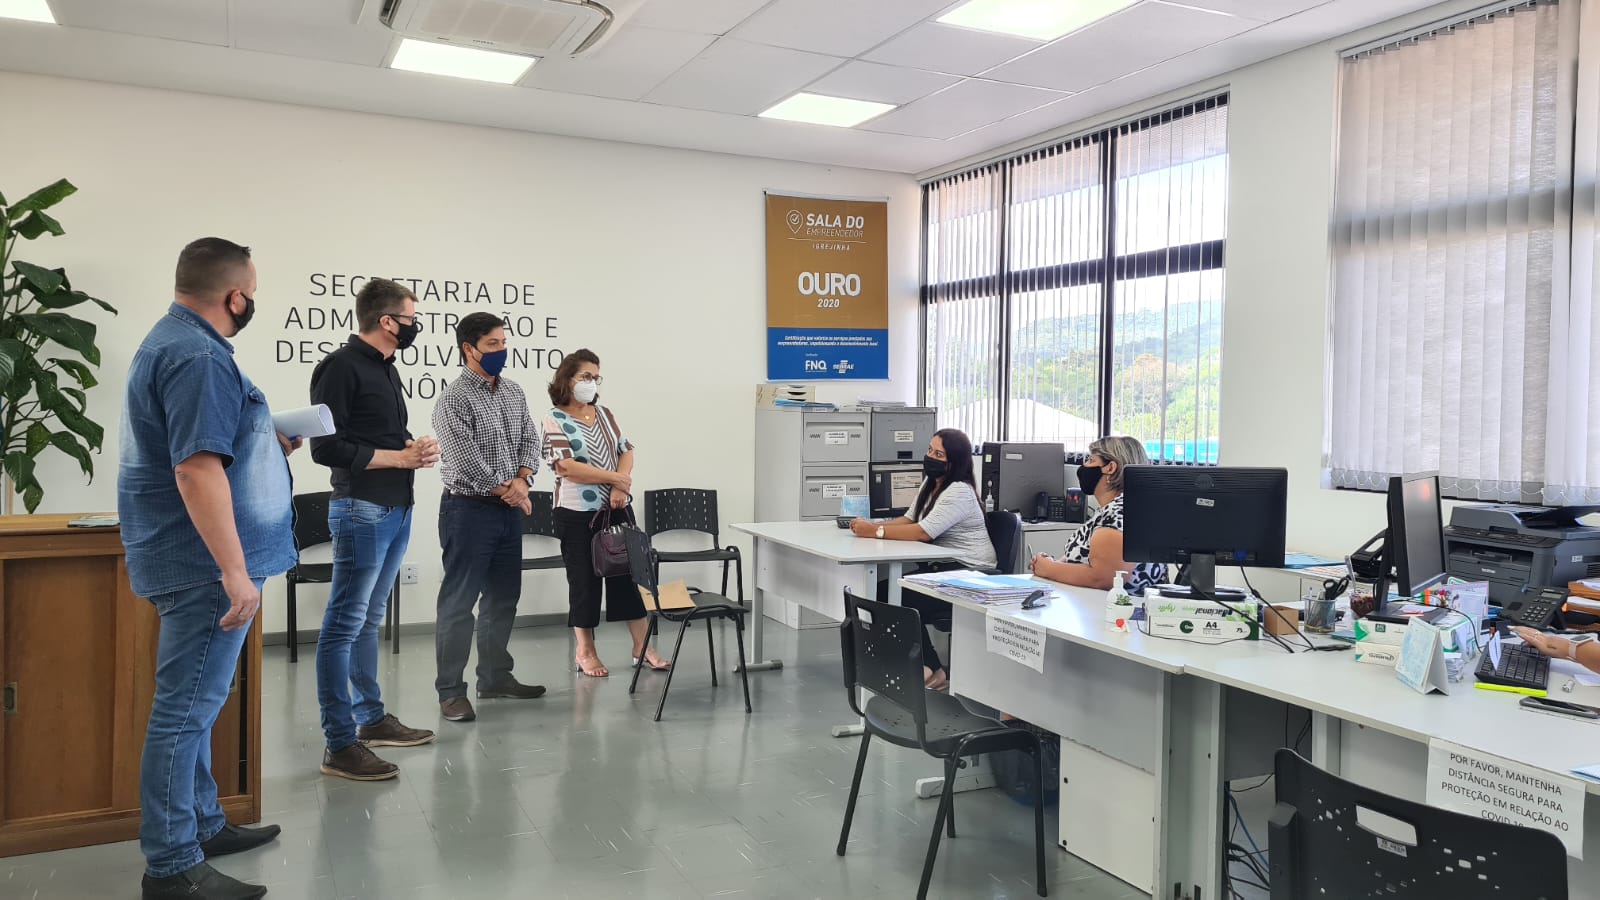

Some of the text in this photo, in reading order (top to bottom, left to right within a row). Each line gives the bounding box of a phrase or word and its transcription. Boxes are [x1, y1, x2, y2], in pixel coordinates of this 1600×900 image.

[806, 213, 865, 229] SALA DO
[806, 227, 864, 238] EMPREENDEDOR
[812, 243, 851, 251] IGREJINHA
[310, 273, 536, 306] SECTARIA DE
[797, 271, 862, 297] OURO
[817, 298, 840, 308] 2020
[285, 306, 558, 338] ADMSTRÃO E
[276, 340, 564, 370] DESOLVINTO
[805, 359, 828, 371] FNQ
[1205, 621, 1218, 629] A4
[1450, 753, 1562, 795] POR FAVOR, MANTENHA
[1448, 767, 1563, 813] DISTÂNCIA SEGURA PARA
[1441, 781, 1569, 832] PROTEÇÃO EM RELAÇÃO AO
